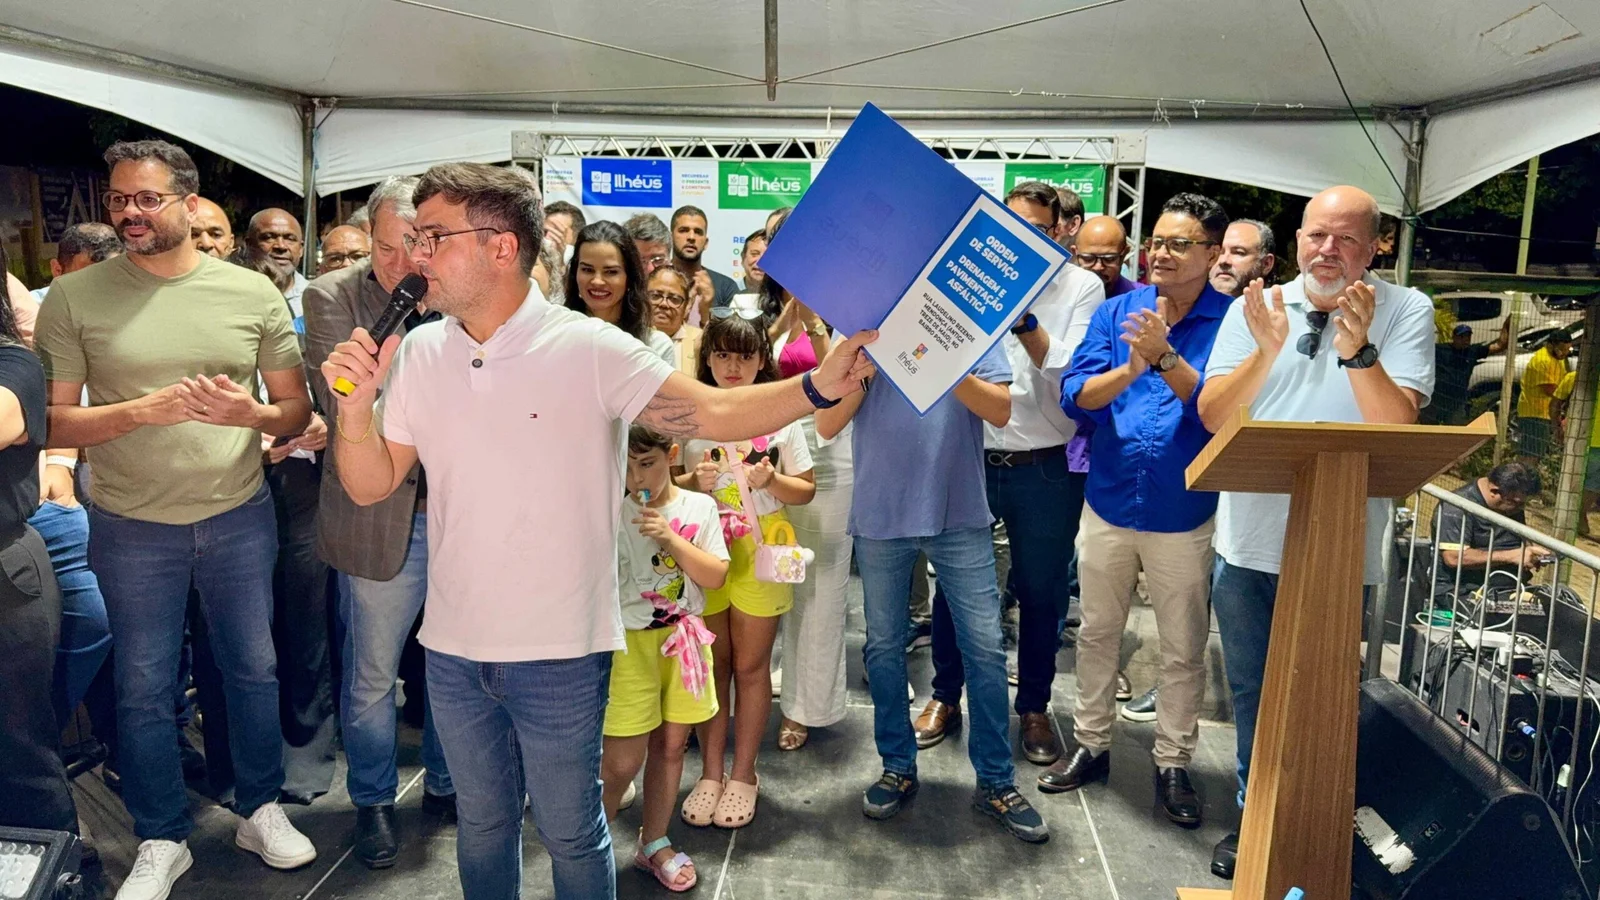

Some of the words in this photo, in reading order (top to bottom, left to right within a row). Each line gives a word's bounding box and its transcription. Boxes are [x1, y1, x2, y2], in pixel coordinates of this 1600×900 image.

[614, 173, 663, 189] Ilhéus
[751, 176, 801, 192] Ilhéus
[969, 238, 984, 252] DE
[981, 248, 1019, 280] SERVIÇO
[986, 236, 1018, 264] ORDEM
[946, 260, 1003, 312] PAVIMENTAÇÃO
[958, 255, 1001, 293] DRENAGEM
[998, 288, 1007, 298] E
[947, 278, 986, 314] ASFÁLTICA
[920, 310, 933, 324] TREZE
[932, 322, 940, 330] DE
[951, 340, 959, 349] NO
[923, 292, 933, 303] RUA
[932, 301, 956, 325] LAUDELINO
[955, 322, 976, 343] REZENDE
[924, 304, 948, 328] MENDONÇA
[918, 319, 934, 336] BAIRRO
[934, 334, 950, 352] PONTAL
[898, 351, 918, 374] Ilhéus
